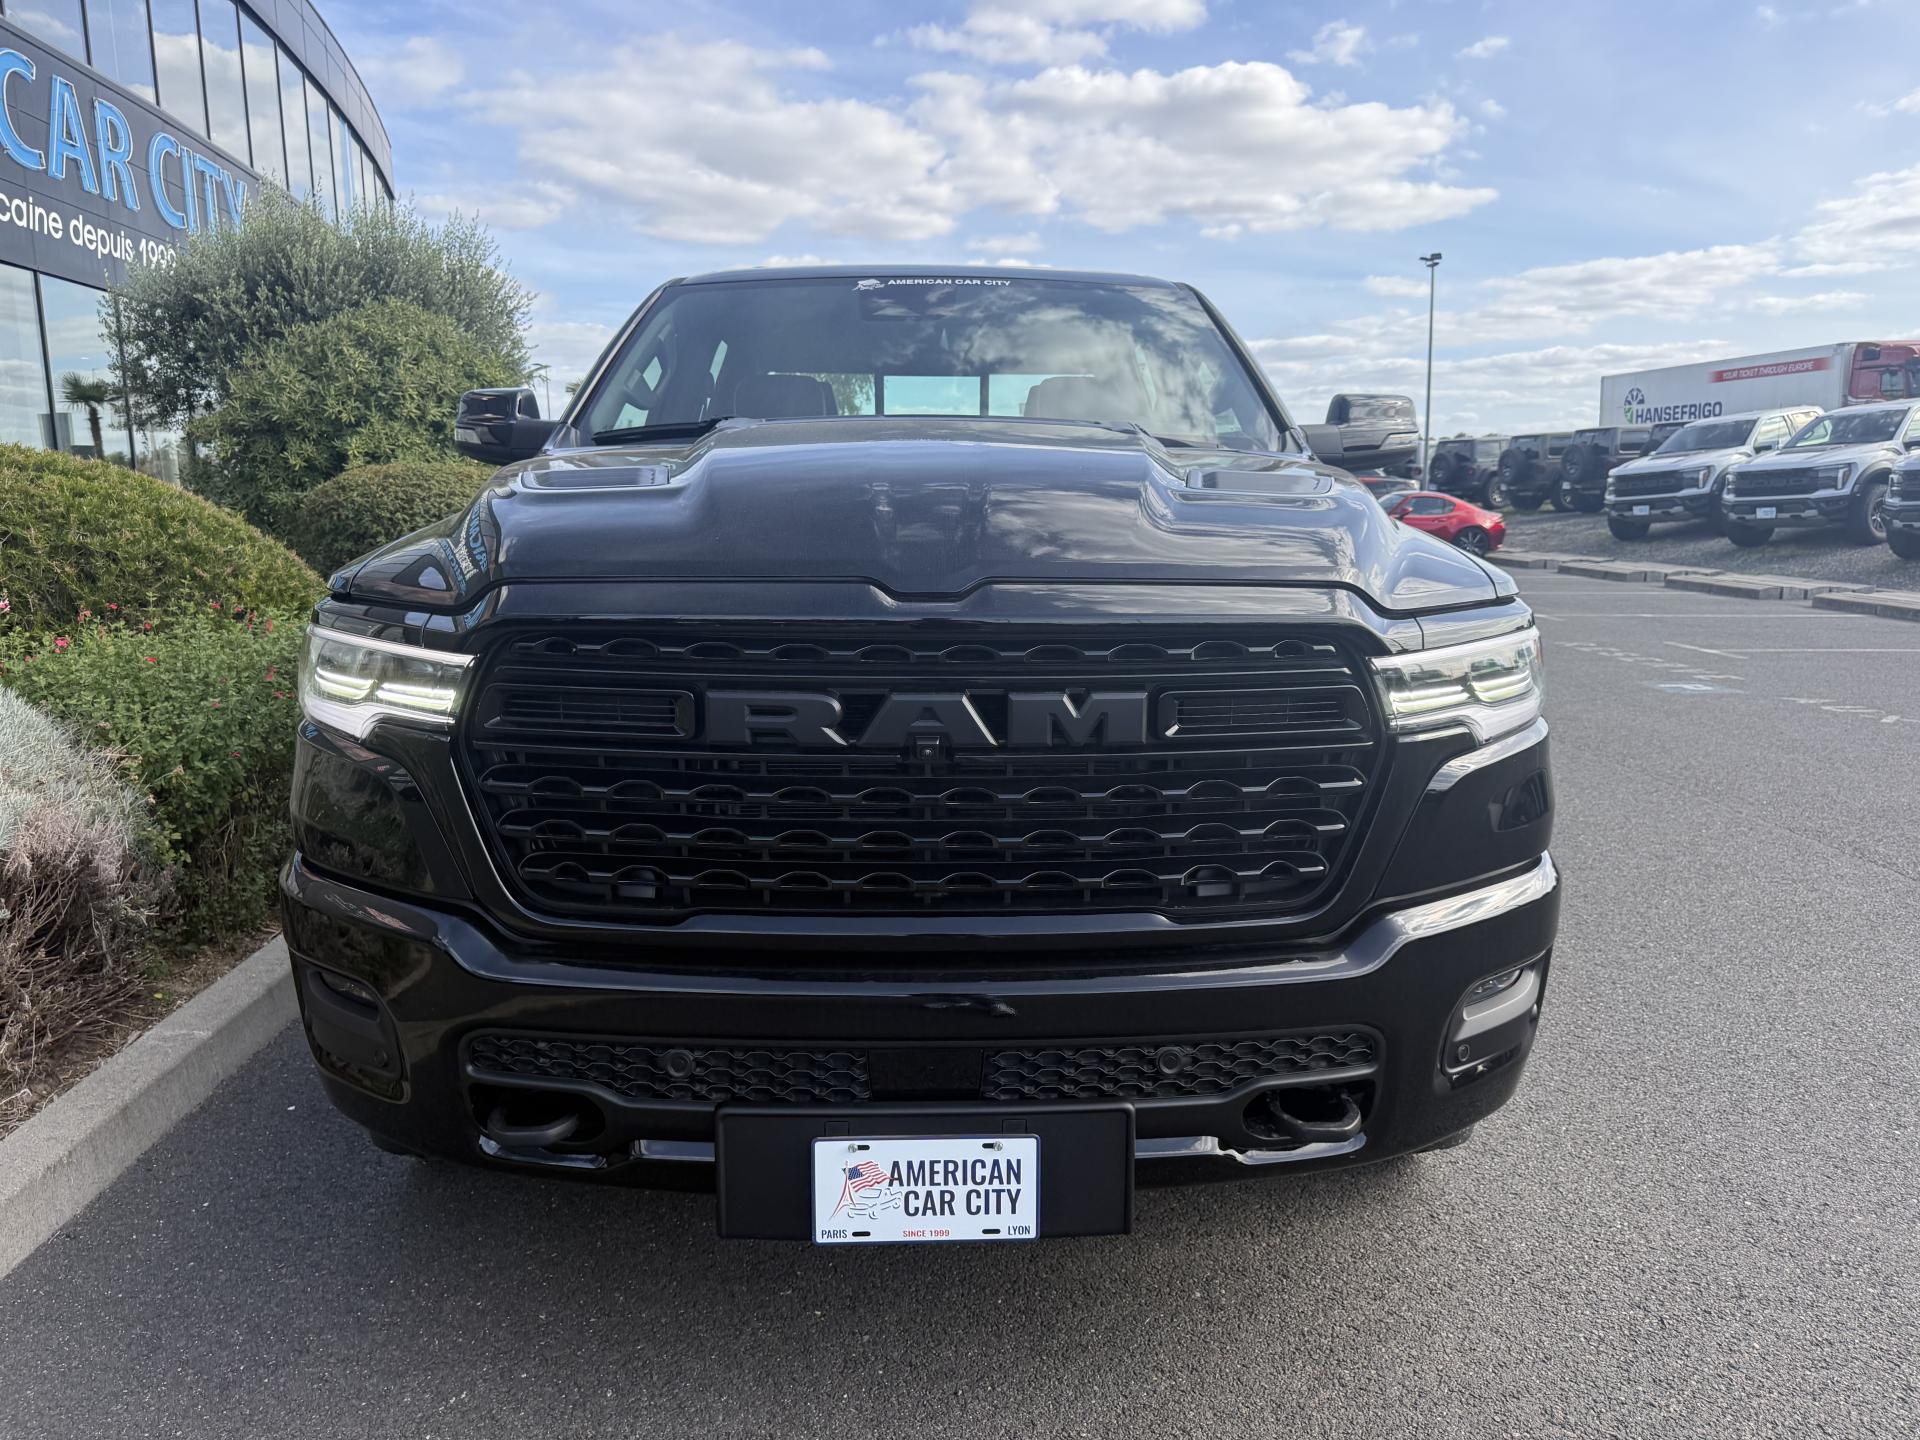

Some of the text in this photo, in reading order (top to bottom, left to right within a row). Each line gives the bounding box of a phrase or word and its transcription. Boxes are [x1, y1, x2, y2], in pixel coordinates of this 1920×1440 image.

[0, 47, 247, 236] CAR CITY
[69, 214, 134, 263] depuis
[887, 278, 952, 286] AMERICAN
[955, 278, 981, 286] CAR
[1722, 361, 1814, 380] YOUR TICKET THROUGH EUROPE
[1635, 401, 1723, 424] HANSEFRIGO
[705, 690, 1148, 745] RAM
[888, 1159, 1022, 1187] AMERICAN
[903, 1188, 1022, 1217] CAR CITY
[821, 1229, 848, 1239] PARIS
[902, 1229, 950, 1238] SINCE 1999
[1007, 1225, 1031, 1236] LYON
